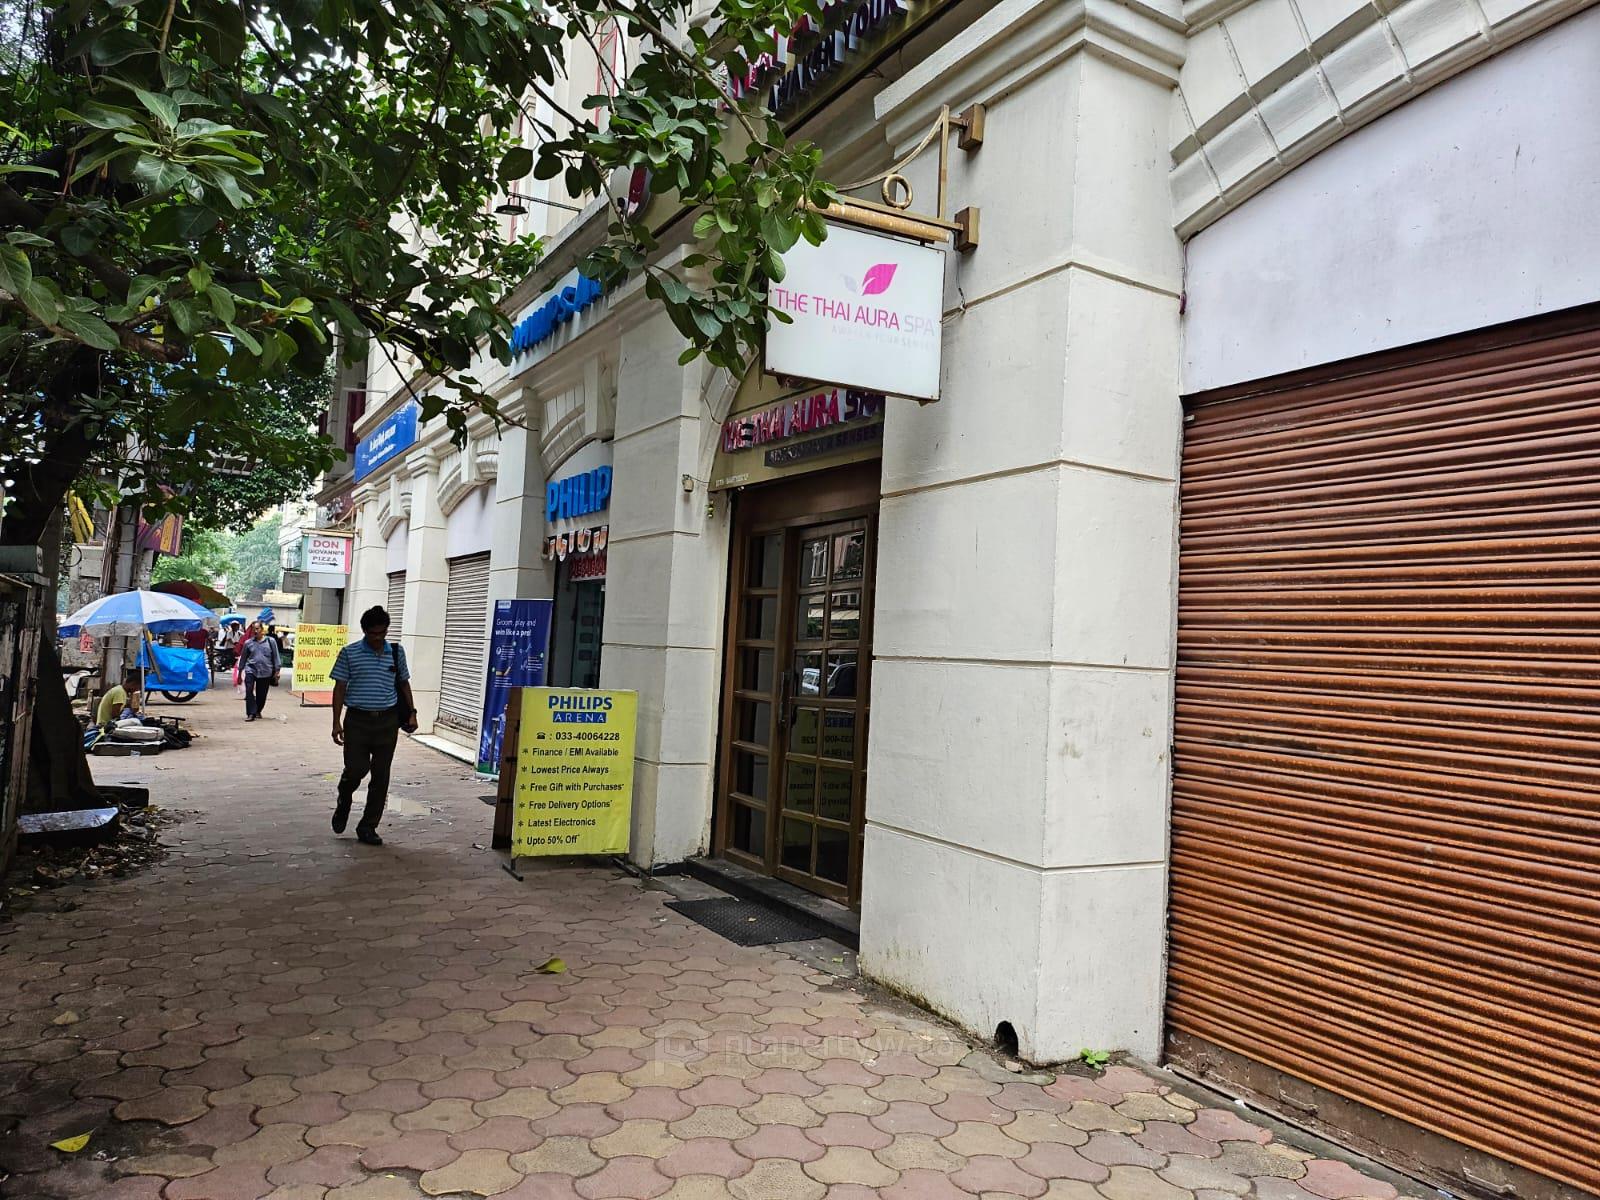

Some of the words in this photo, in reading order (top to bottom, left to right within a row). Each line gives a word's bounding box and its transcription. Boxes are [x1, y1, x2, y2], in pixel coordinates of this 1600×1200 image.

[775, 288, 808, 313] THE
[813, 297, 850, 322] THAI
[854, 305, 900, 331] AURA
[904, 314, 936, 336] SPA
[789, 388, 842, 434] AURA
[546, 465, 613, 522] PHILIP
[313, 540, 339, 549] DON
[310, 674, 324, 682] COFFEE
[548, 695, 613, 710] PHILIPS
[554, 712, 605, 722] ARENA
[555, 732, 620, 741] 033-40064228
[532, 748, 563, 756] Finance
[569, 748, 583, 756] EMI
[585, 748, 619, 756] Available
[531, 766, 559, 774] Lowest
[582, 766, 609, 775] Always
[530, 783, 547, 792] Free
[549, 783, 563, 791] Gift
[565, 783, 581, 791] with
[529, 801, 546, 809] Free
[548, 801, 579, 810] Delivery
[528, 819, 552, 827] Latest
[553, 818, 596, 826] Electronics
[527, 837, 545, 846] Upto
[547, 836, 563, 844] 50%
